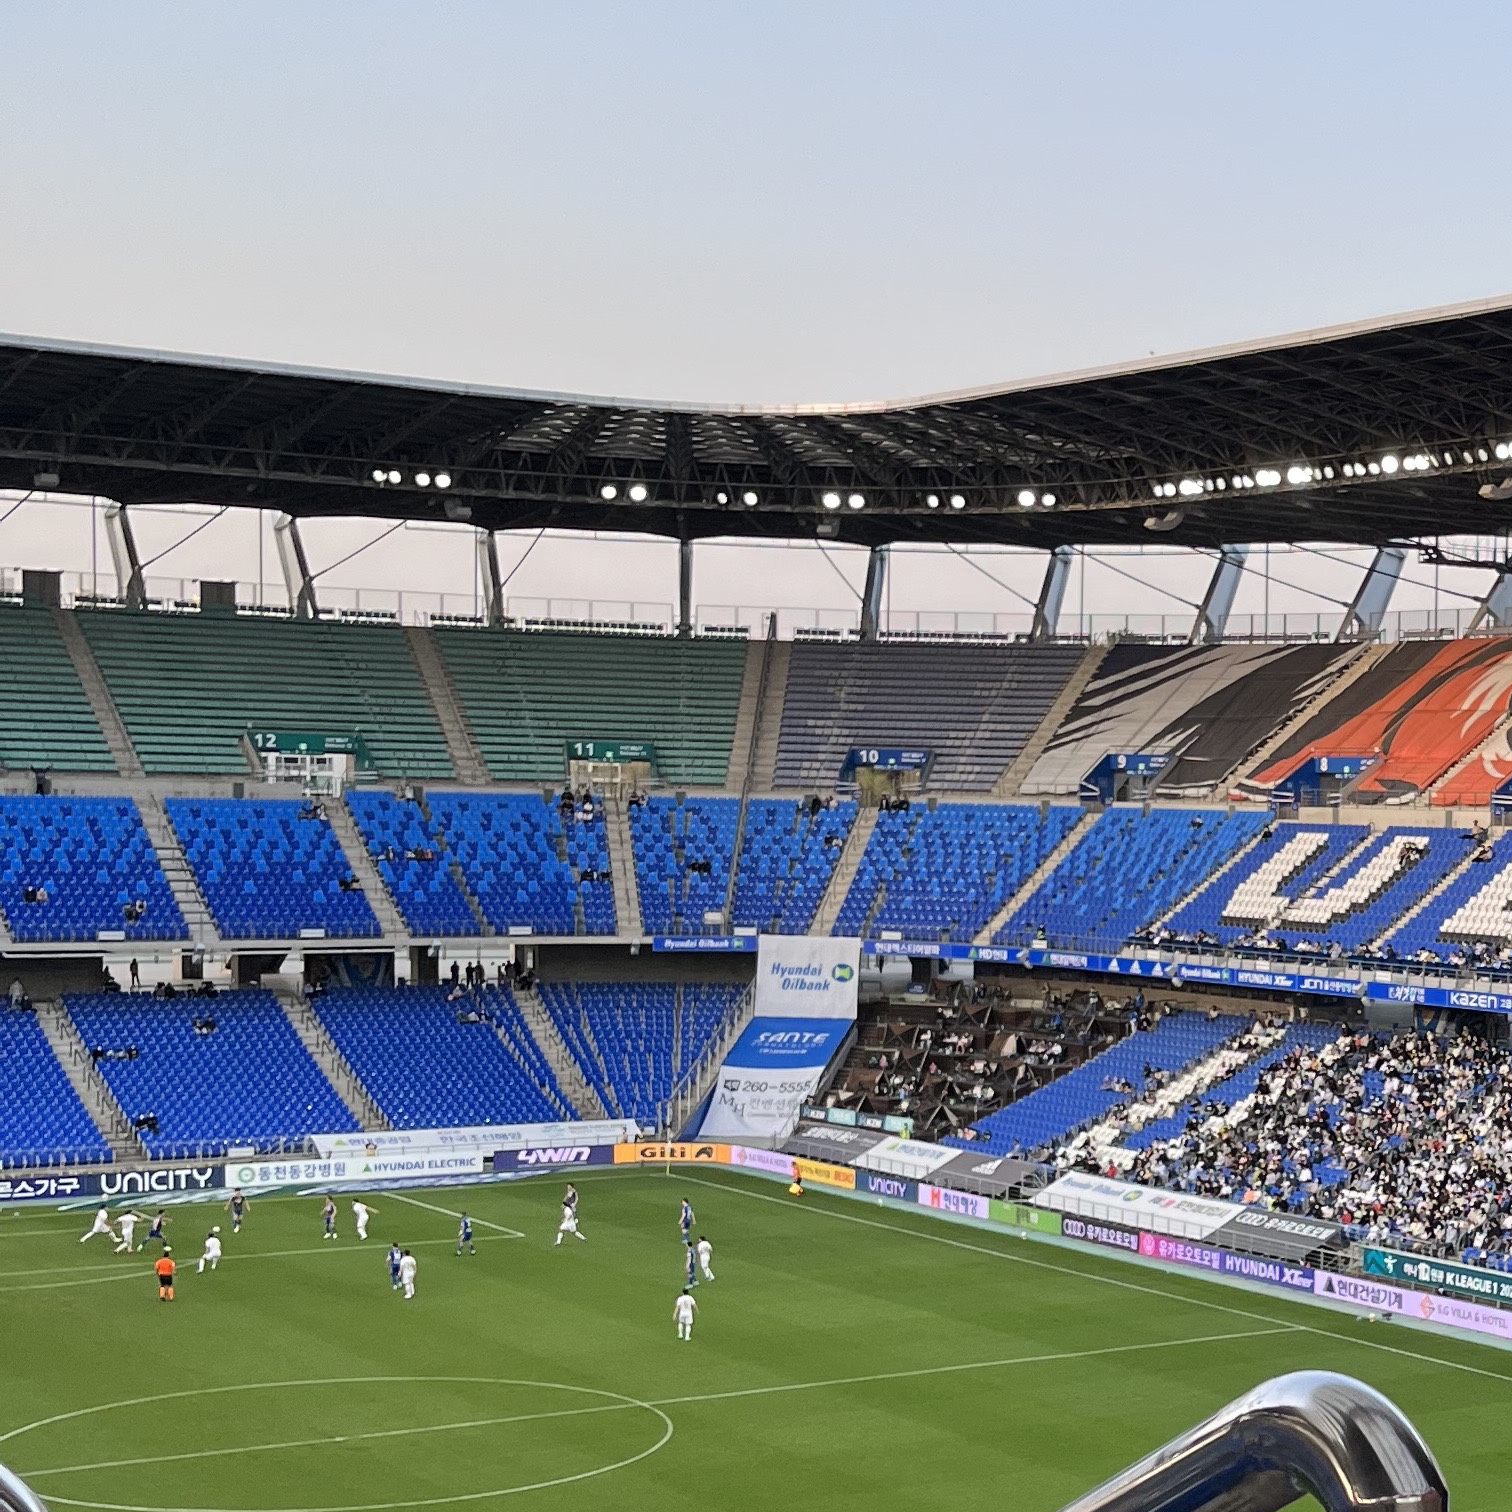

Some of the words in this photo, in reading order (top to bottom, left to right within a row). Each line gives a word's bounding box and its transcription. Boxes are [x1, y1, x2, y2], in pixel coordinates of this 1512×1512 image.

[254, 734, 277, 748] 12
[574, 743, 595, 757] 11
[858, 750, 879, 763] 10
[1117, 754, 1127, 768] 9
[664, 938, 697, 949] Hyundai
[771, 962, 823, 978] Hyundai
[781, 977, 831, 991] Oilbank
[1238, 972, 1273, 985] HYUNDAI
[757, 1031, 831, 1045] SANTE
[742, 1079, 812, 1094] 260-5555
[517, 1146, 591, 1164] 4WIN
[640, 1145, 686, 1158] Giti
[257, 1162, 346, 1181] 동천동강병원
[373, 1160, 425, 1173] HYUNDAI
[427, 1156, 477, 1170] ELECTRIC
[868, 1177, 906, 1198] UNICITY
[943, 1190, 978, 1217] 현대해상
[1086, 1223, 1138, 1250] 유카로오토모빌
[1159, 1239, 1220, 1270] 유카로오토모빌
[1225, 1254, 1280, 1281] HYUNDAI
[1337, 1278, 1403, 1310] 현대건설기계
